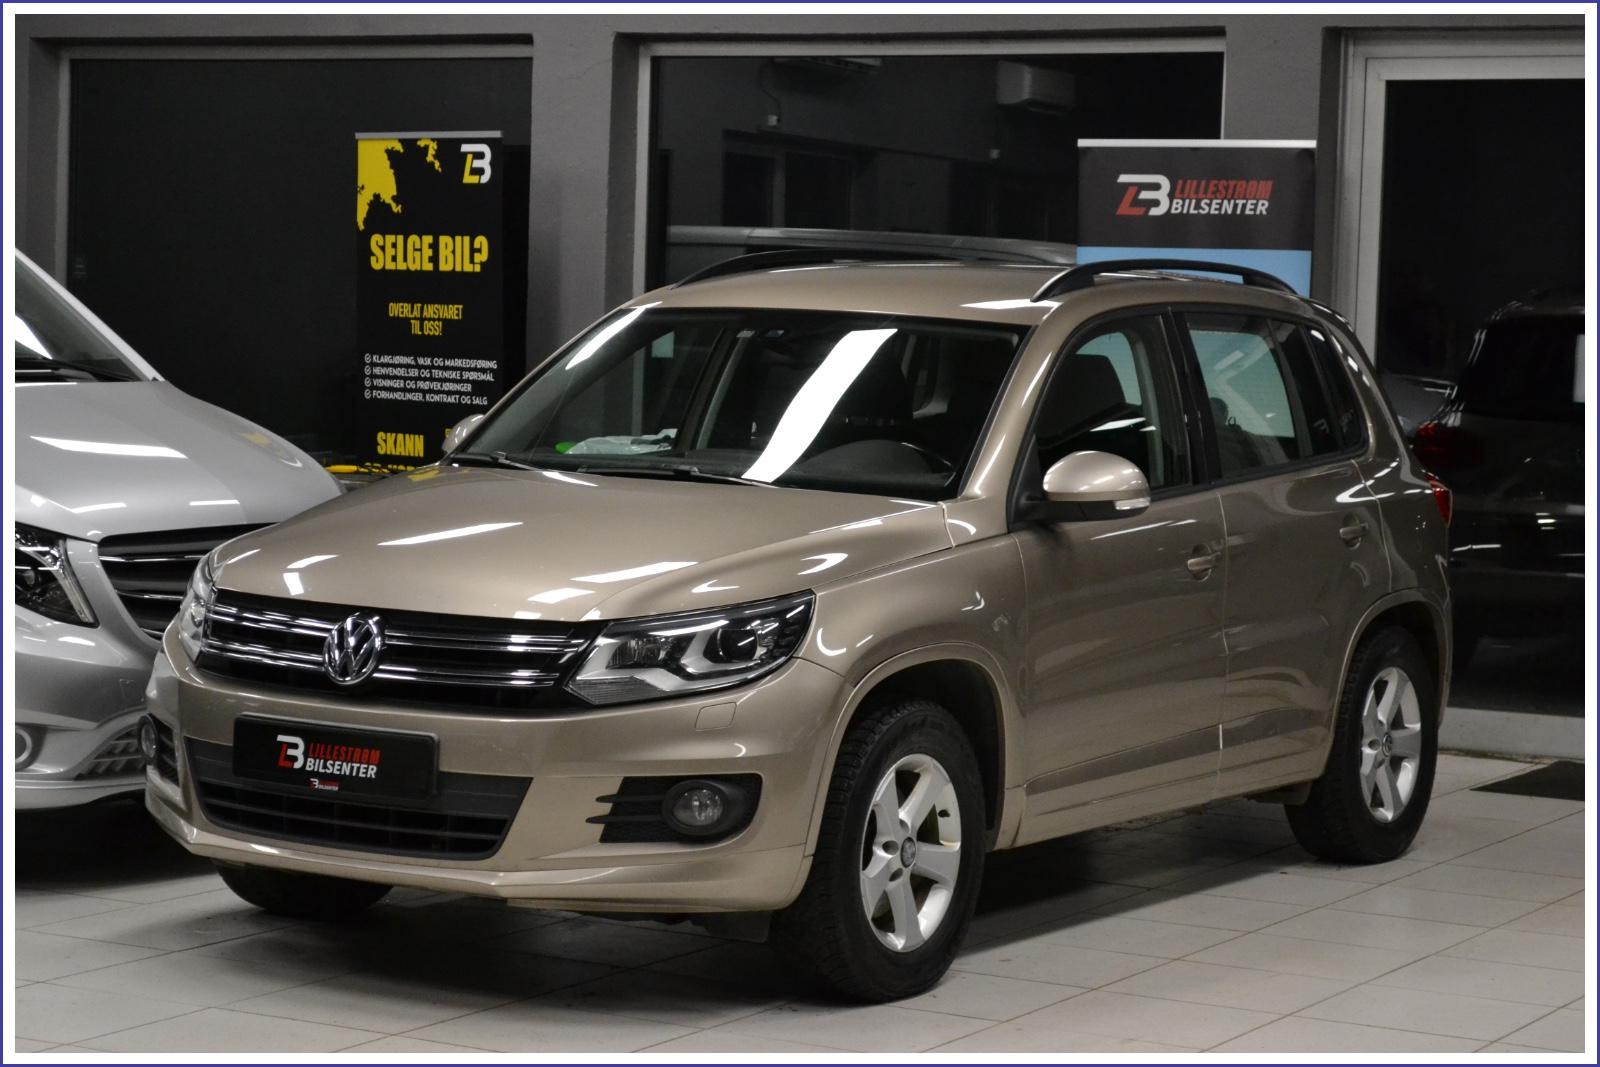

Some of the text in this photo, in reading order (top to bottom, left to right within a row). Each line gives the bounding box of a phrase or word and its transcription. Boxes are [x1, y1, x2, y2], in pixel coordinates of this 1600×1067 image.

[1174, 179, 1274, 200] LILLESTRØM
[1170, 199, 1269, 215] BILSENTER
[370, 233, 489, 272] SELGE BIL?
[388, 302, 463, 320] OVERLAT ANSVARET
[410, 320, 443, 336] TIL OSS!
[372, 354, 498, 369] KLARGJØRING, VASK OG MARKEDSFØRING
[372, 366, 495, 382] HENVENDELSER OG TEKNISKE SPØRSMÅL
[372, 378, 472, 392] VISNINGER OG PRØVEKJØRINGER
[372, 390, 488, 405] FORHANDLINGER, KONTRAKT OG SALG
[376, 431, 424, 457] SKANN
[308, 742, 382, 765] LILLESTRØM
[305, 757, 377, 779] BILSENTER
